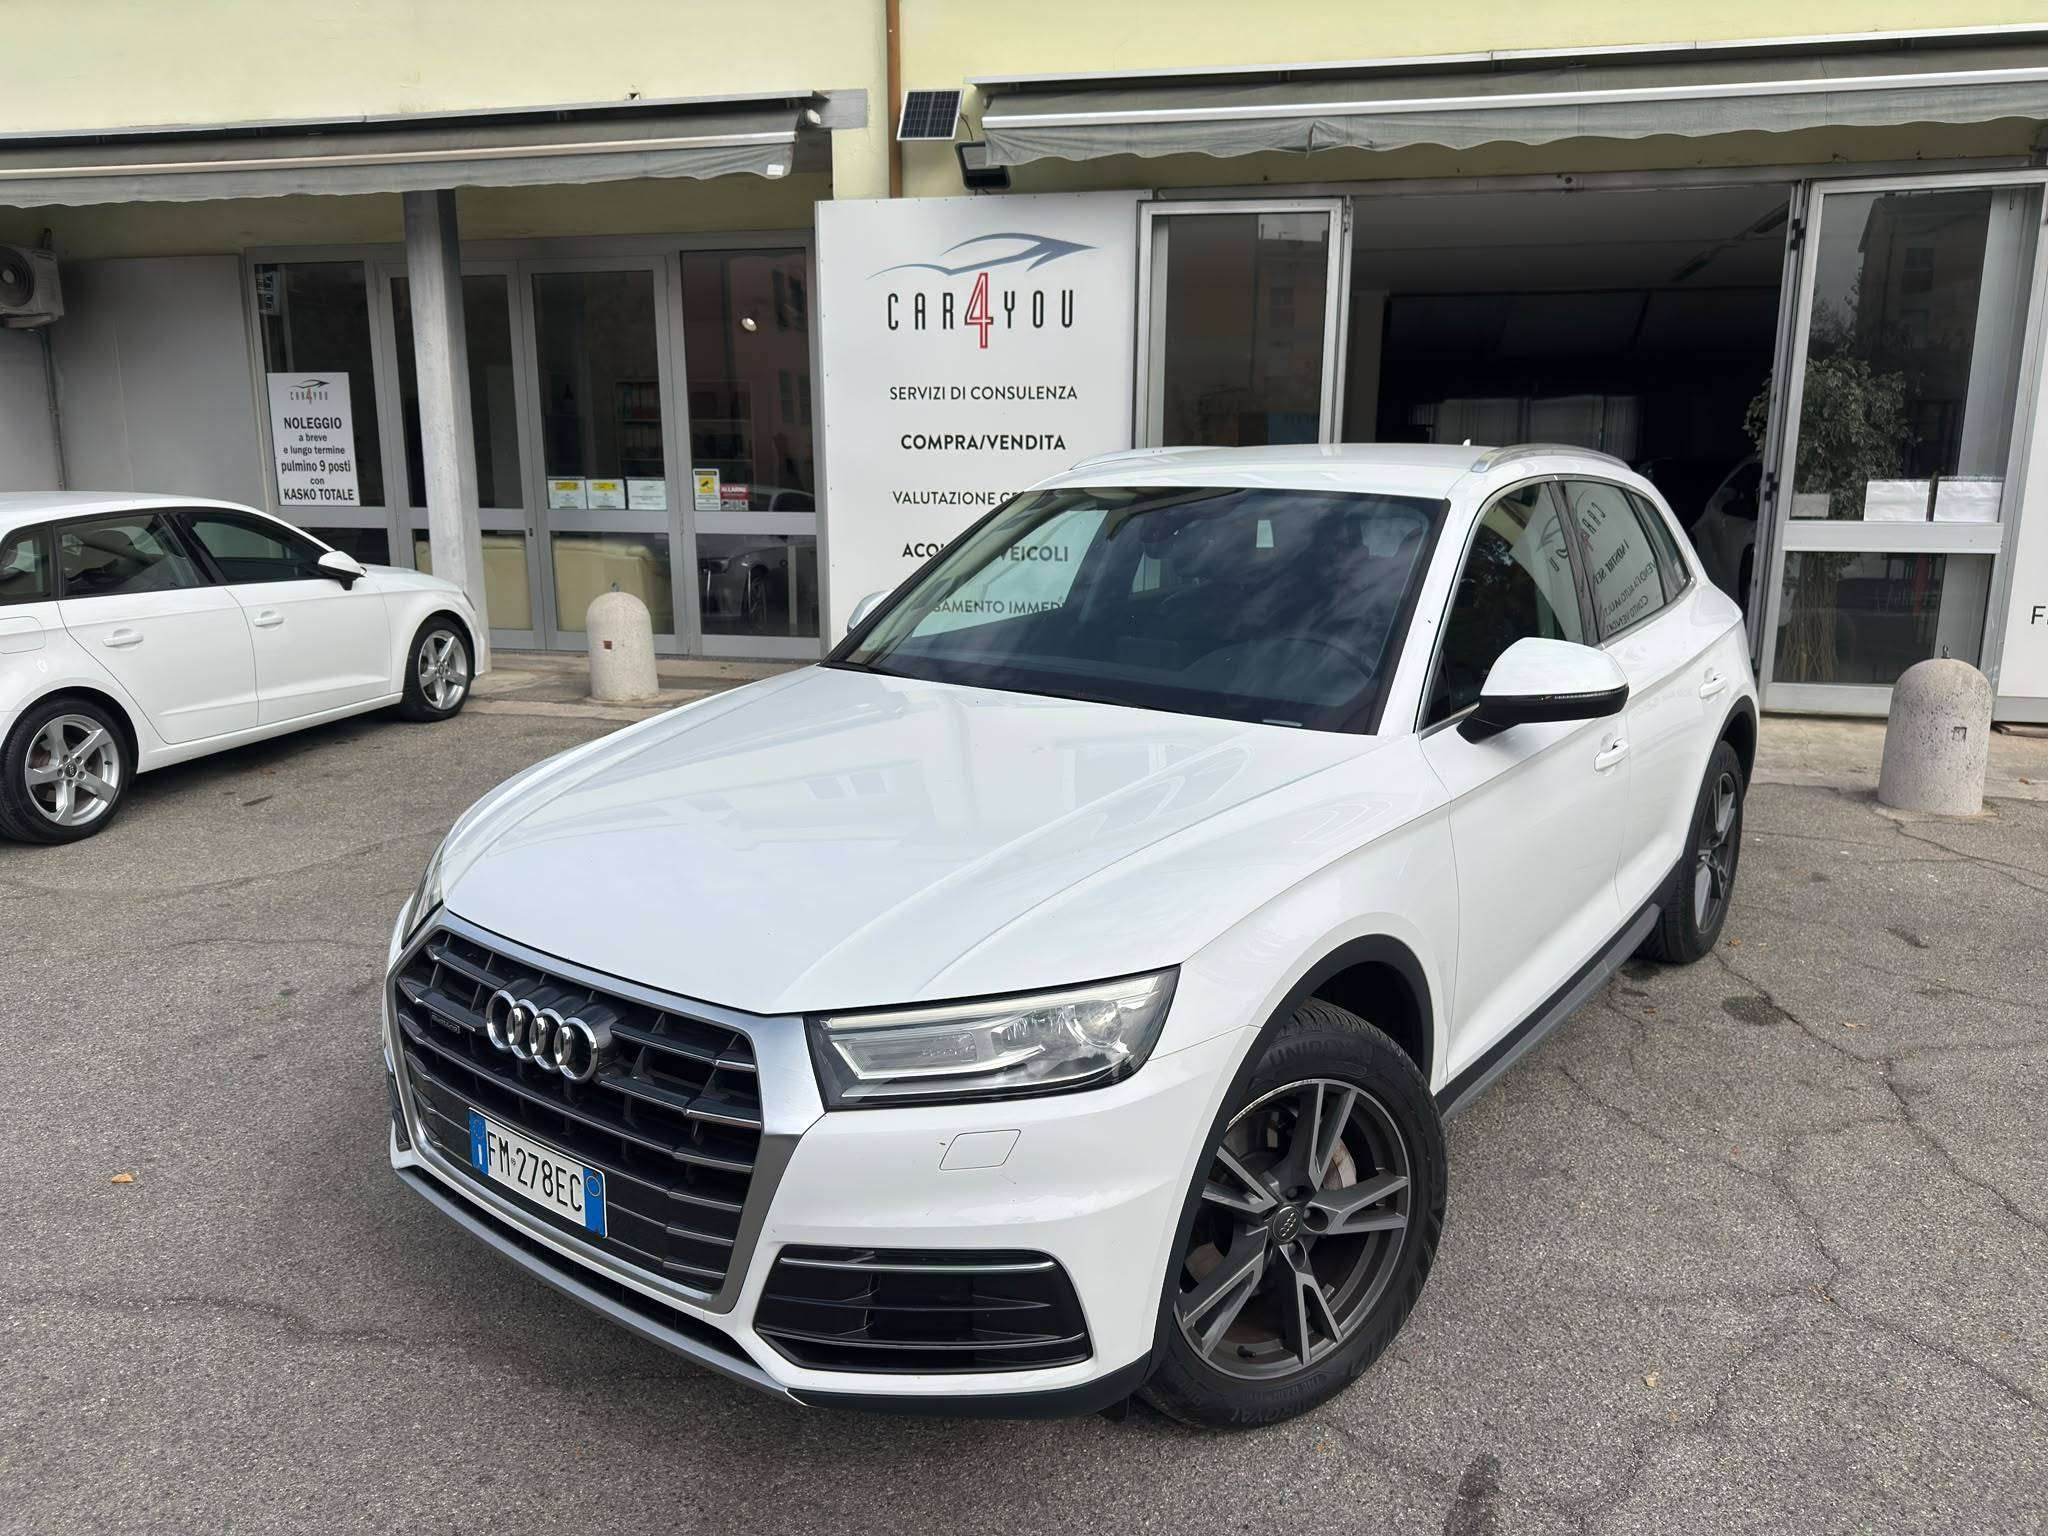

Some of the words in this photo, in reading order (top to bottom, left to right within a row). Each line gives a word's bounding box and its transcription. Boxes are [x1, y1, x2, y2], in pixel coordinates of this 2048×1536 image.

[889, 386, 946, 400] SERVIZI
[950, 386, 966, 400] DI
[970, 385, 1078, 400] CONSULENZA
[284, 417, 342, 429] NOLEGGIO
[305, 433, 327, 441] breve
[900, 434, 1067, 450] COMPRA/VENDITA
[290, 446, 312, 456] lungo
[314, 446, 345, 454] termine
[281, 460, 317, 474] pulmino
[319, 460, 326, 472] 9
[328, 460, 351, 474] posti
[284, 489, 316, 500] KASKO
[319, 489, 354, 501] TOTALE
[892, 491, 996, 504] VALUTAZIONE
[933, 600, 1005, 613] GAMENTO
[2031, 605, 2048, 625] F
